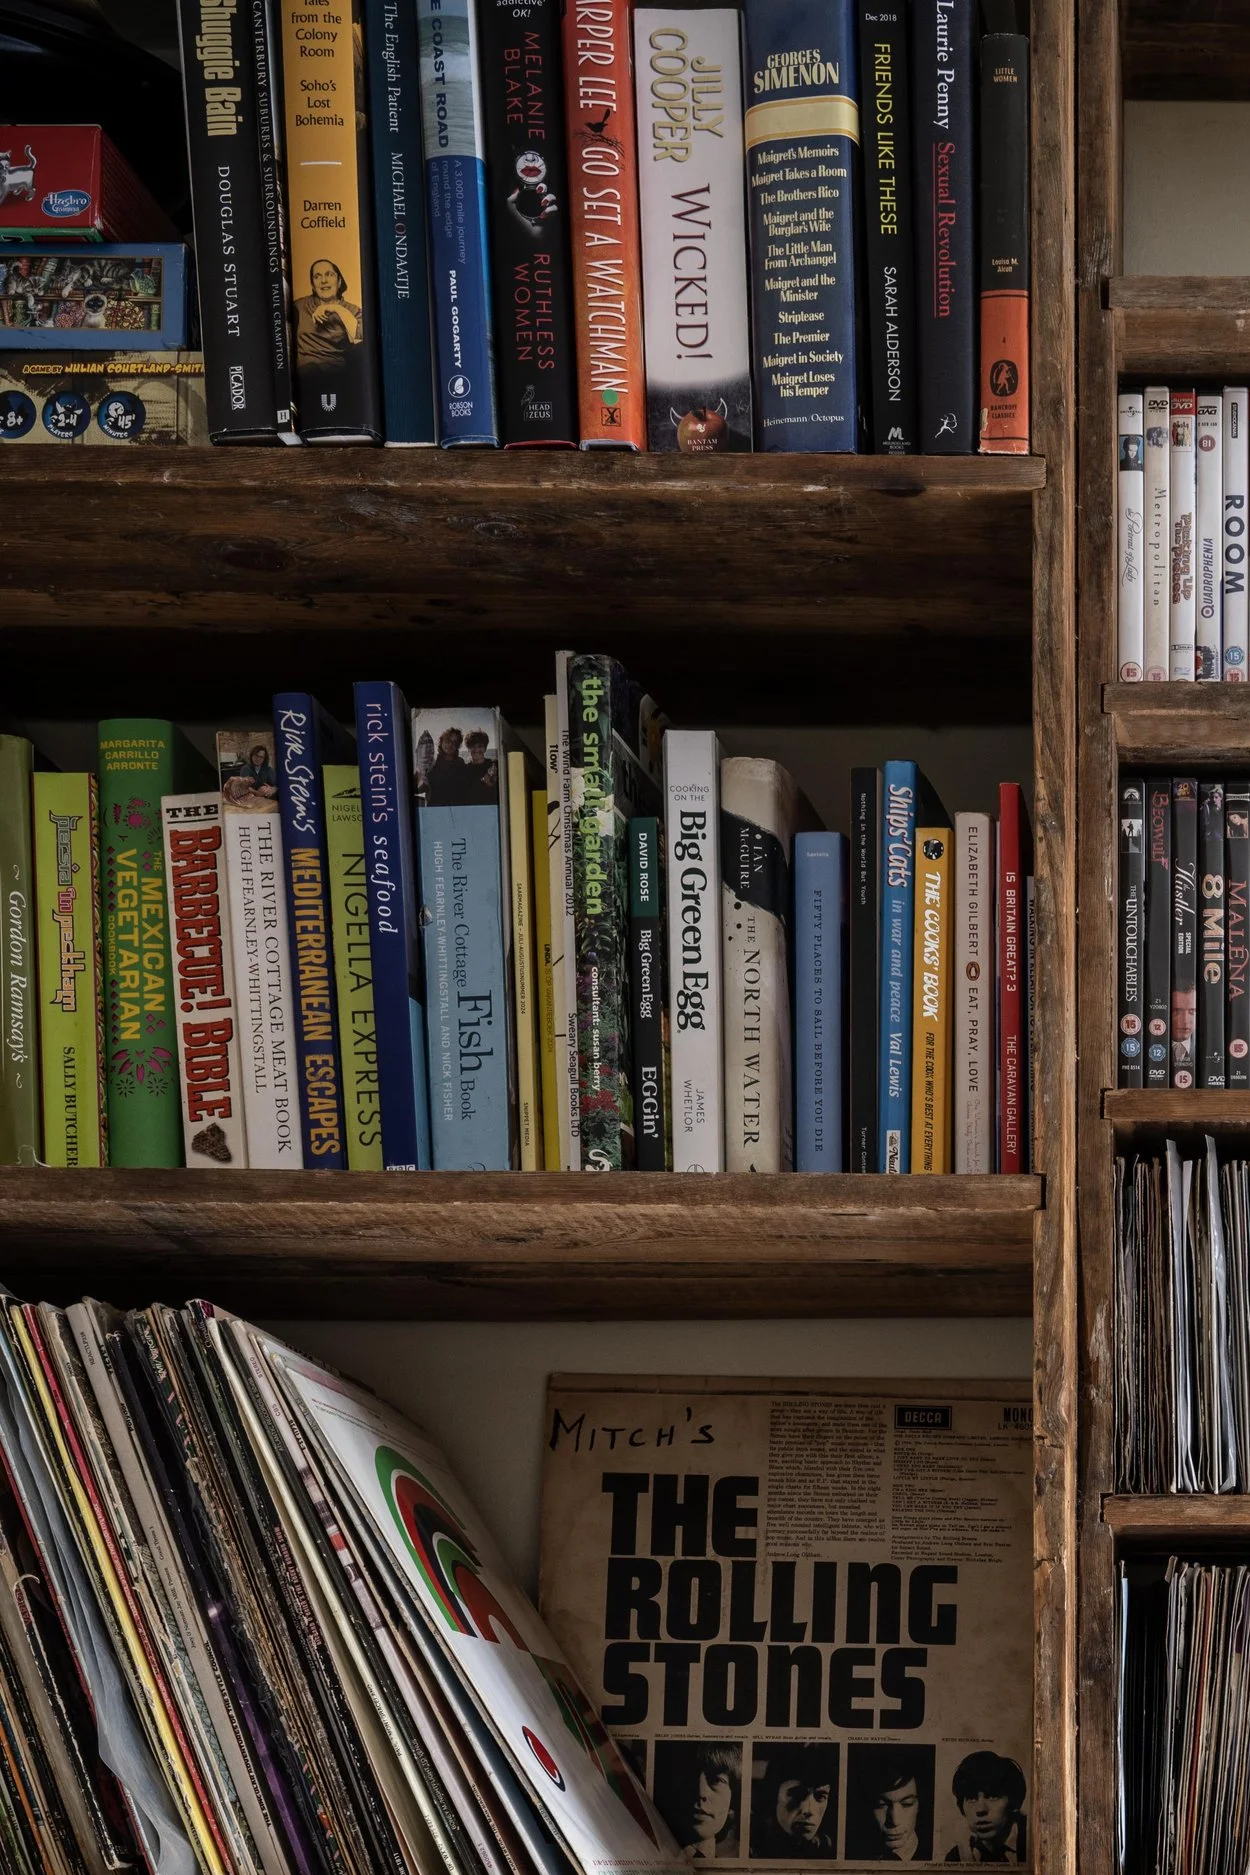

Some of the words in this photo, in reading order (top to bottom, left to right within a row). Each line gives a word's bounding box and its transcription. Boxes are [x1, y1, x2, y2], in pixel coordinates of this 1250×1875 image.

[194, 0, 241, 80] Shuggie
[252, 0, 267, 87] CANTERBURY
[295, 29, 337, 43] Colony
[384, 3, 398, 30] The
[935, 0, 953, 61] Laurie
[300, 46, 334, 58] Room
[381, 33, 400, 81] English
[431, 18, 447, 88] COAST
[753, 65, 839, 95] SIMENON
[766, 49, 820, 68] GEORGES
[204, 87, 242, 136] Bain
[300, 80, 336, 91] Soho's
[307, 98, 331, 109] Lost
[386, 86, 402, 132] Patient
[503, 49, 523, 124] BLAKE
[525, 32, 545, 140] MELANIE
[650, 28, 691, 163] COOPER
[691, 57, 725, 138] JILLY
[873, 43, 892, 125] FRIENDS
[932, 68, 954, 129] Penny
[257, 91, 271, 149] SUBURBS
[295, 115, 344, 127] Bohemia
[435, 93, 449, 148] ROAD
[581, 147, 618, 175] GO
[877, 132, 894, 170] LIKE
[936, 142, 955, 205] Sexual
[44, 192, 88, 207] Hasbro
[217, 165, 235, 256] DOUGLAS
[303, 200, 341, 212] Darren
[391, 152, 406, 219] MICHAEL
[582, 187, 621, 225] SET
[878, 176, 897, 235] THESE
[262, 167, 278, 273] SURROUNDINGS
[300, 217, 345, 229] Coffield
[584, 232, 623, 248] A
[394, 222, 409, 299] ONDAATJE
[448, 269, 459, 302] PAUL
[937, 212, 955, 317] Revolution
[223, 264, 239, 337] STUART
[513, 264, 533, 361] WOMEN
[533, 254, 554, 370] RUTHLESS
[778, 311, 824, 324] Striptease
[883, 266, 898, 317] SARAH
[449, 306, 462, 368] GOGARTY
[586, 259, 628, 394] WATCHMAN
[65, 364, 104, 373] JULIAN
[230, 366, 245, 410] PICADOR
[886, 322, 900, 401] ALDERSON
[1149, 488, 1165, 606] Metropolitan
[366, 703, 385, 743] rick
[581, 677, 602, 724] the
[369, 752, 393, 823] stein's
[583, 732, 605, 810] small
[238, 826, 252, 873] HUGH
[257, 822, 272, 866] THE
[451, 839, 466, 872] The
[674, 810, 707, 861] Big
[967, 827, 978, 897] ELIZABETH
[372, 835, 397, 934] seafood
[580, 818, 604, 915] garden
[923, 872, 941, 905] THE
[169, 827, 231, 1012] BARBECUE!
[260, 871, 277, 930] RIVER
[343, 852, 373, 991] NIGELLA
[453, 875, 467, 919] River
[677, 867, 707, 968] Green
[1006, 889, 1016, 933] BRITAIN
[6, 890, 26, 966] Gordon
[115, 849, 140, 1041] VEGETARIAN
[142, 877, 164, 1012] MEXICAN
[291, 848, 332, 1041] MEDITERRANEAN
[451, 924, 469, 988] Cottage
[967, 902, 978, 956] GILBERT
[241, 877, 266, 1094] FEARNLEY-WHITTINGSTALL
[264, 936, 283, 1034] COTTAGE
[1006, 937, 1016, 981] GREAT?
[8, 972, 28, 1062] Ramsay's
[676, 971, 709, 1030] Egg
[743, 950, 760, 1043] NORTH
[921, 974, 939, 1022] BOOK
[966, 987, 978, 1014] EAT,
[457, 990, 493, 1075] Fish
[889, 1032, 904, 1054] Val
[966, 1020, 978, 1056] PRAY,
[1007, 1035, 1016, 1054] THE
[63, 1046, 76, 1091] SALLY
[181, 1020, 232, 1122] BIBLE
[269, 1039, 287, 1092] MEAT
[352, 1010, 382, 1148] EXPRESS
[888, 1058, 903, 1097] Lewis
[967, 1061, 978, 1092] LOVE
[1006, 1058, 1016, 1104] CARAVAN
[274, 1097, 291, 1153] BOOK
[304, 1054, 340, 1156] ESCAPES
[460, 1080, 475, 1121] Book
[742, 1054, 761, 1148] WATER
[64, 1095, 78, 1167] BUTCHER
[1006, 1108, 1016, 1154] GALLERY
[905, 1411, 943, 1424] DECCA
[601, 1472, 760, 1558] THE
[605, 1557, 958, 1645] ROLLING
[601, 1642, 928, 1730] STONES
